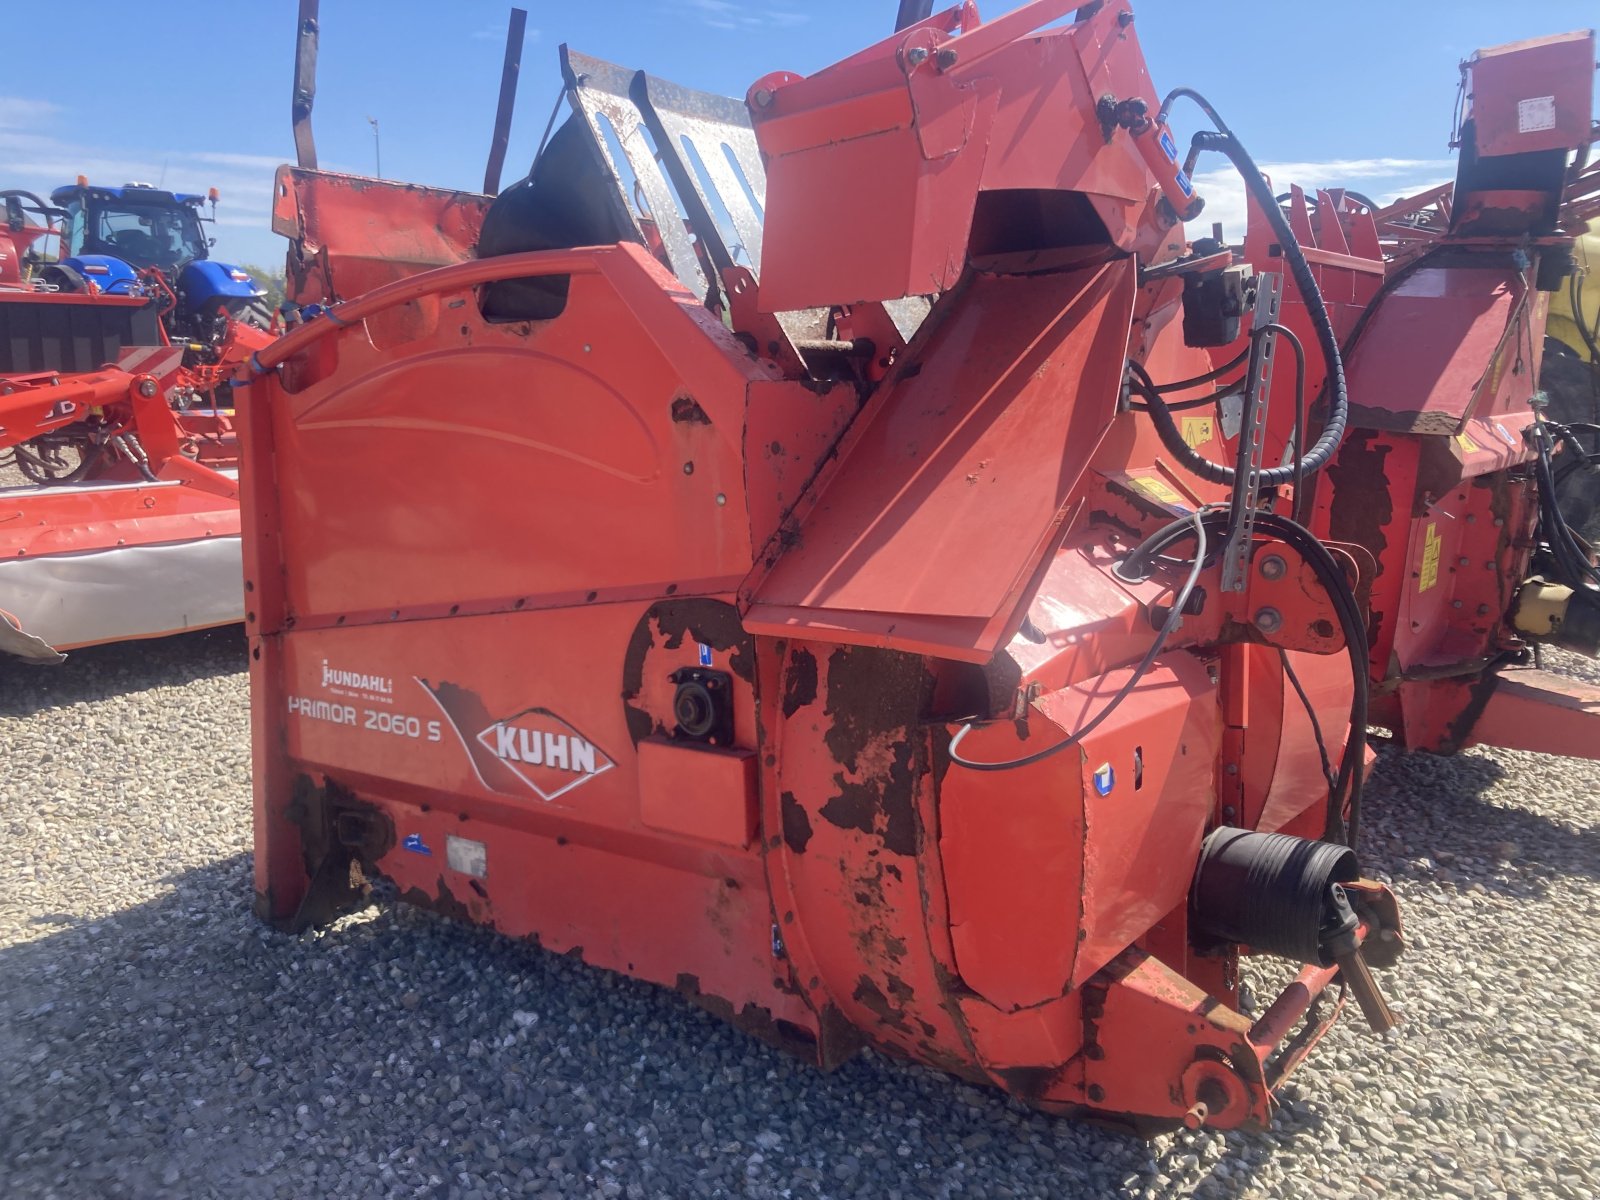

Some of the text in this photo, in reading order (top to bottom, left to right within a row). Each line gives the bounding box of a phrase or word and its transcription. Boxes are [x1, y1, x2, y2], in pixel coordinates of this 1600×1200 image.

[322, 660, 391, 693] HUNDAHL
[288, 696, 441, 742] PRIMOR 2060 S
[496, 725, 595, 774] KUHN
